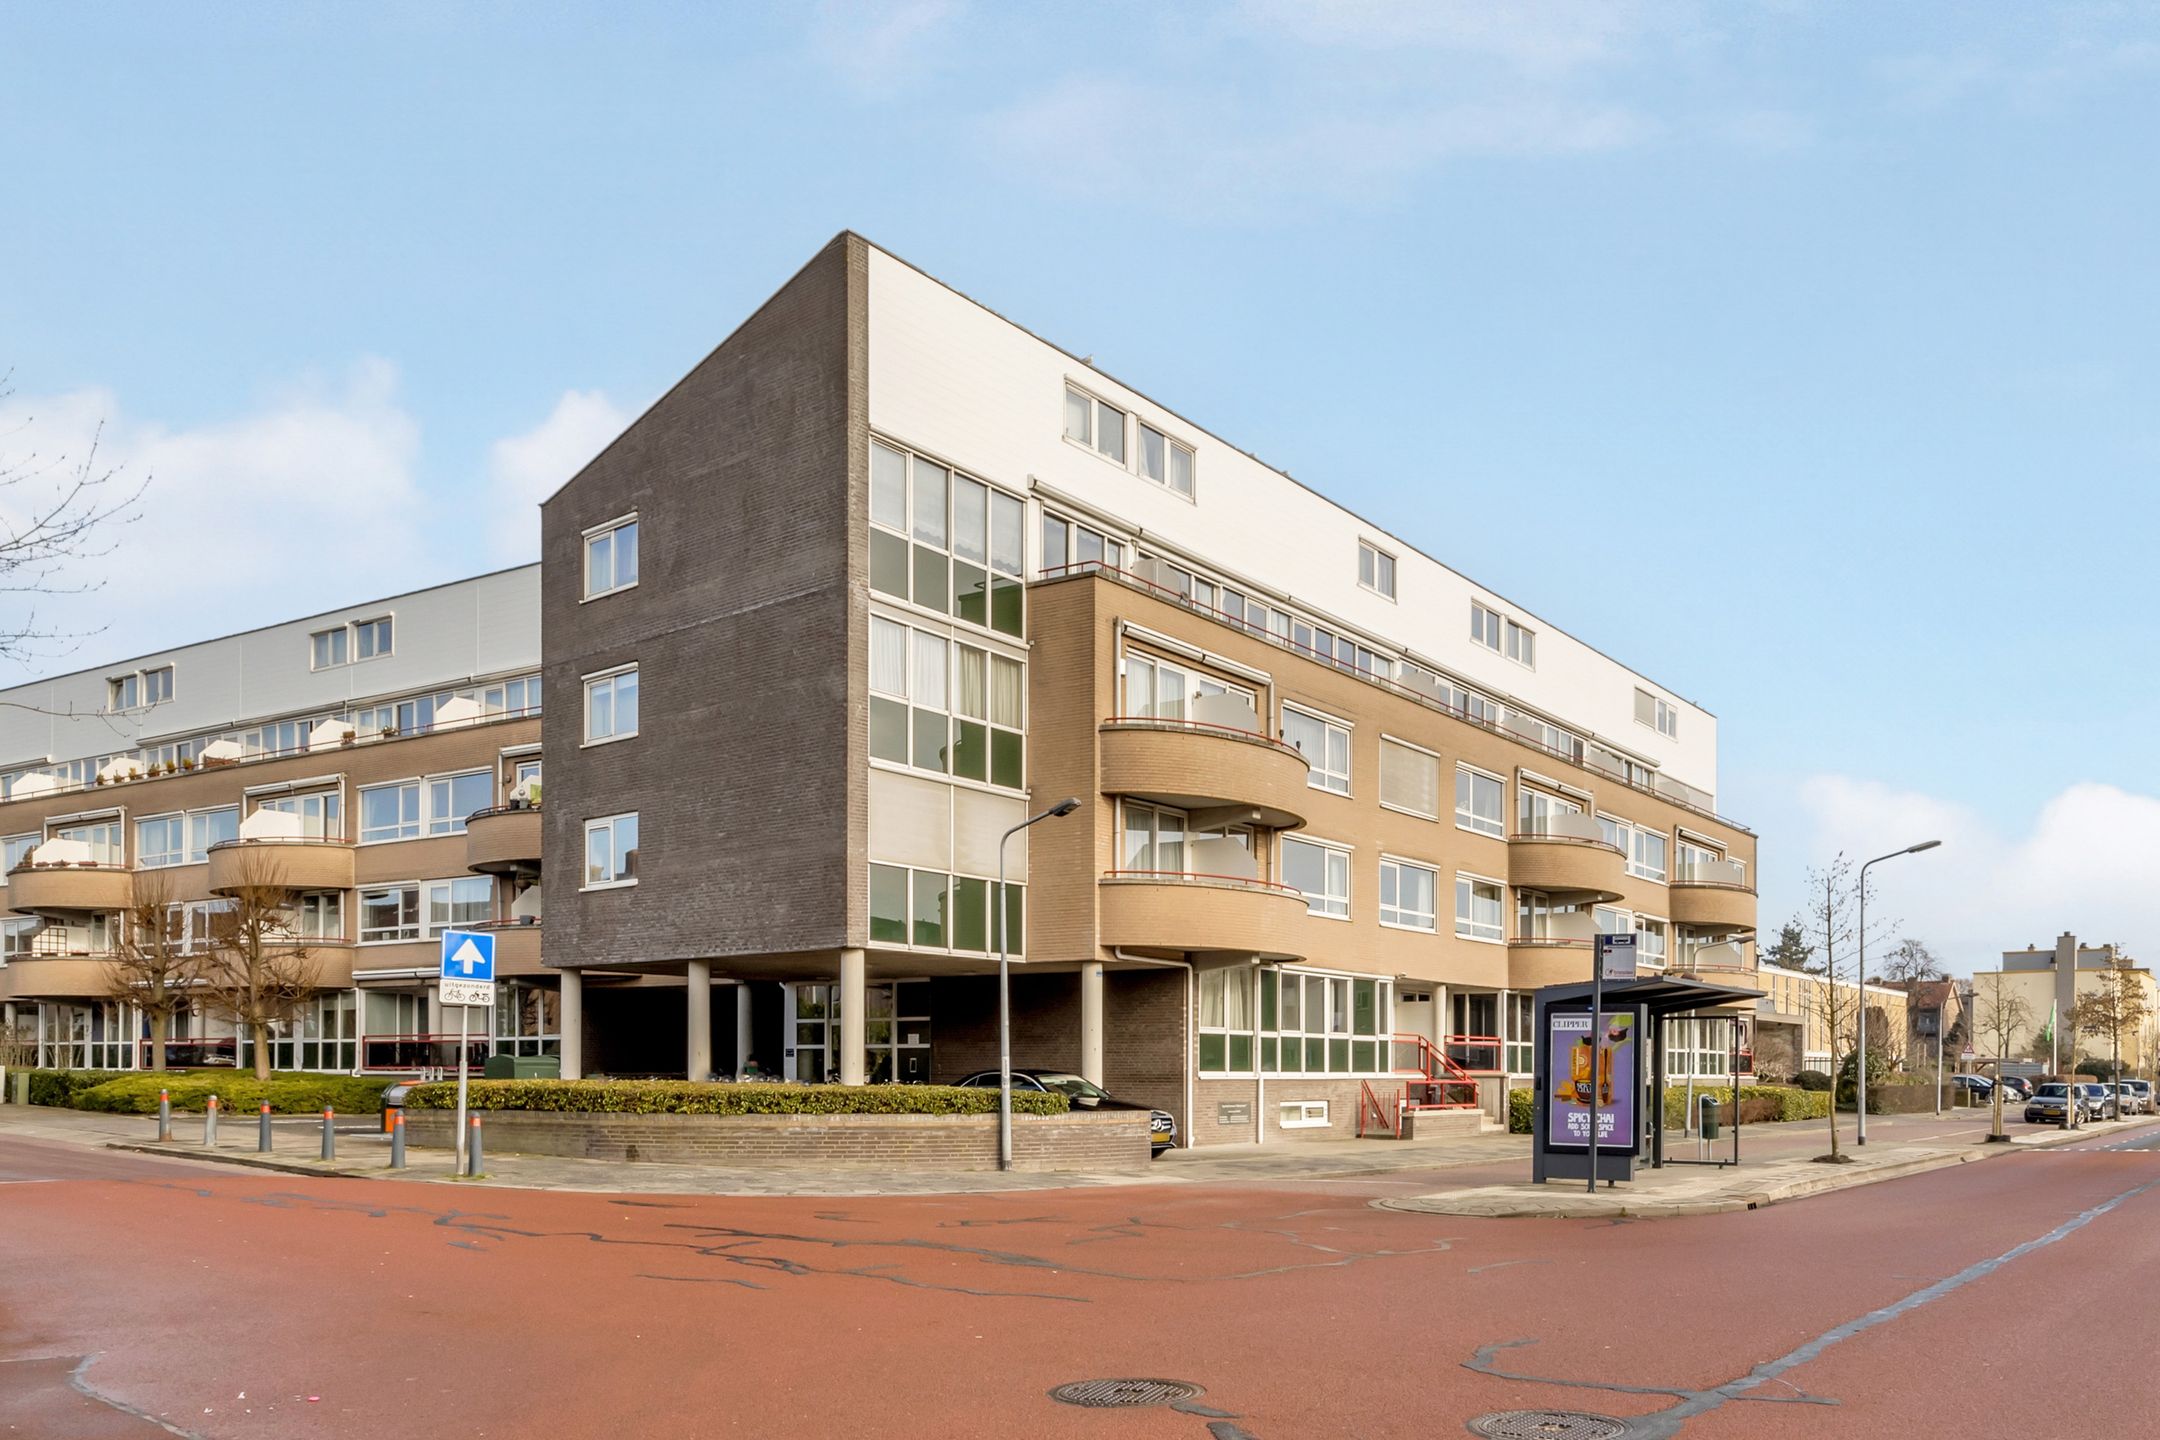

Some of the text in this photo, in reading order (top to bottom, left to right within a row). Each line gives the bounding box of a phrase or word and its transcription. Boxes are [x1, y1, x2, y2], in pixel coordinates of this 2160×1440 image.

[445, 982, 490, 990] uitgezonderd
[1552, 1020, 1588, 1028] CLIPPER
[1568, 1112, 1590, 1123] SPICY
